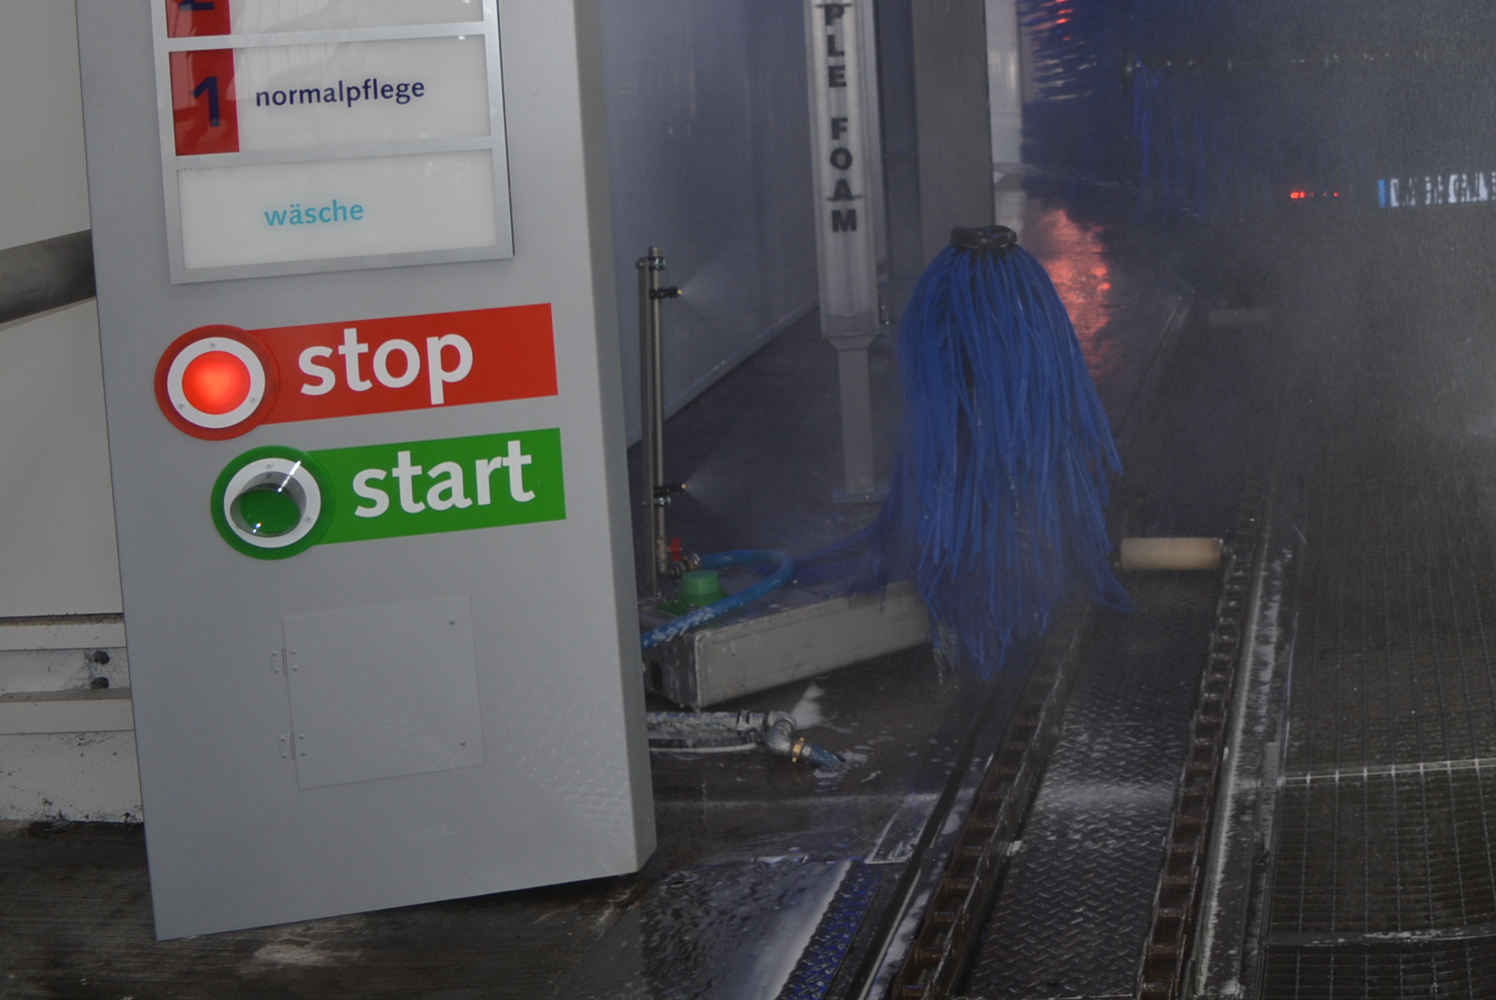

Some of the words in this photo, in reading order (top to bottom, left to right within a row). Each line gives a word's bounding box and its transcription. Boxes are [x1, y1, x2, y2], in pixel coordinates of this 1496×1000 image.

[192, 76, 220, 128] 1
[254, 75, 426, 109] normalpflege
[263, 199, 365, 228] wäsche
[829, 116, 857, 233] FOAM
[298, 327, 474, 405] stop
[352, 439, 536, 518] start
